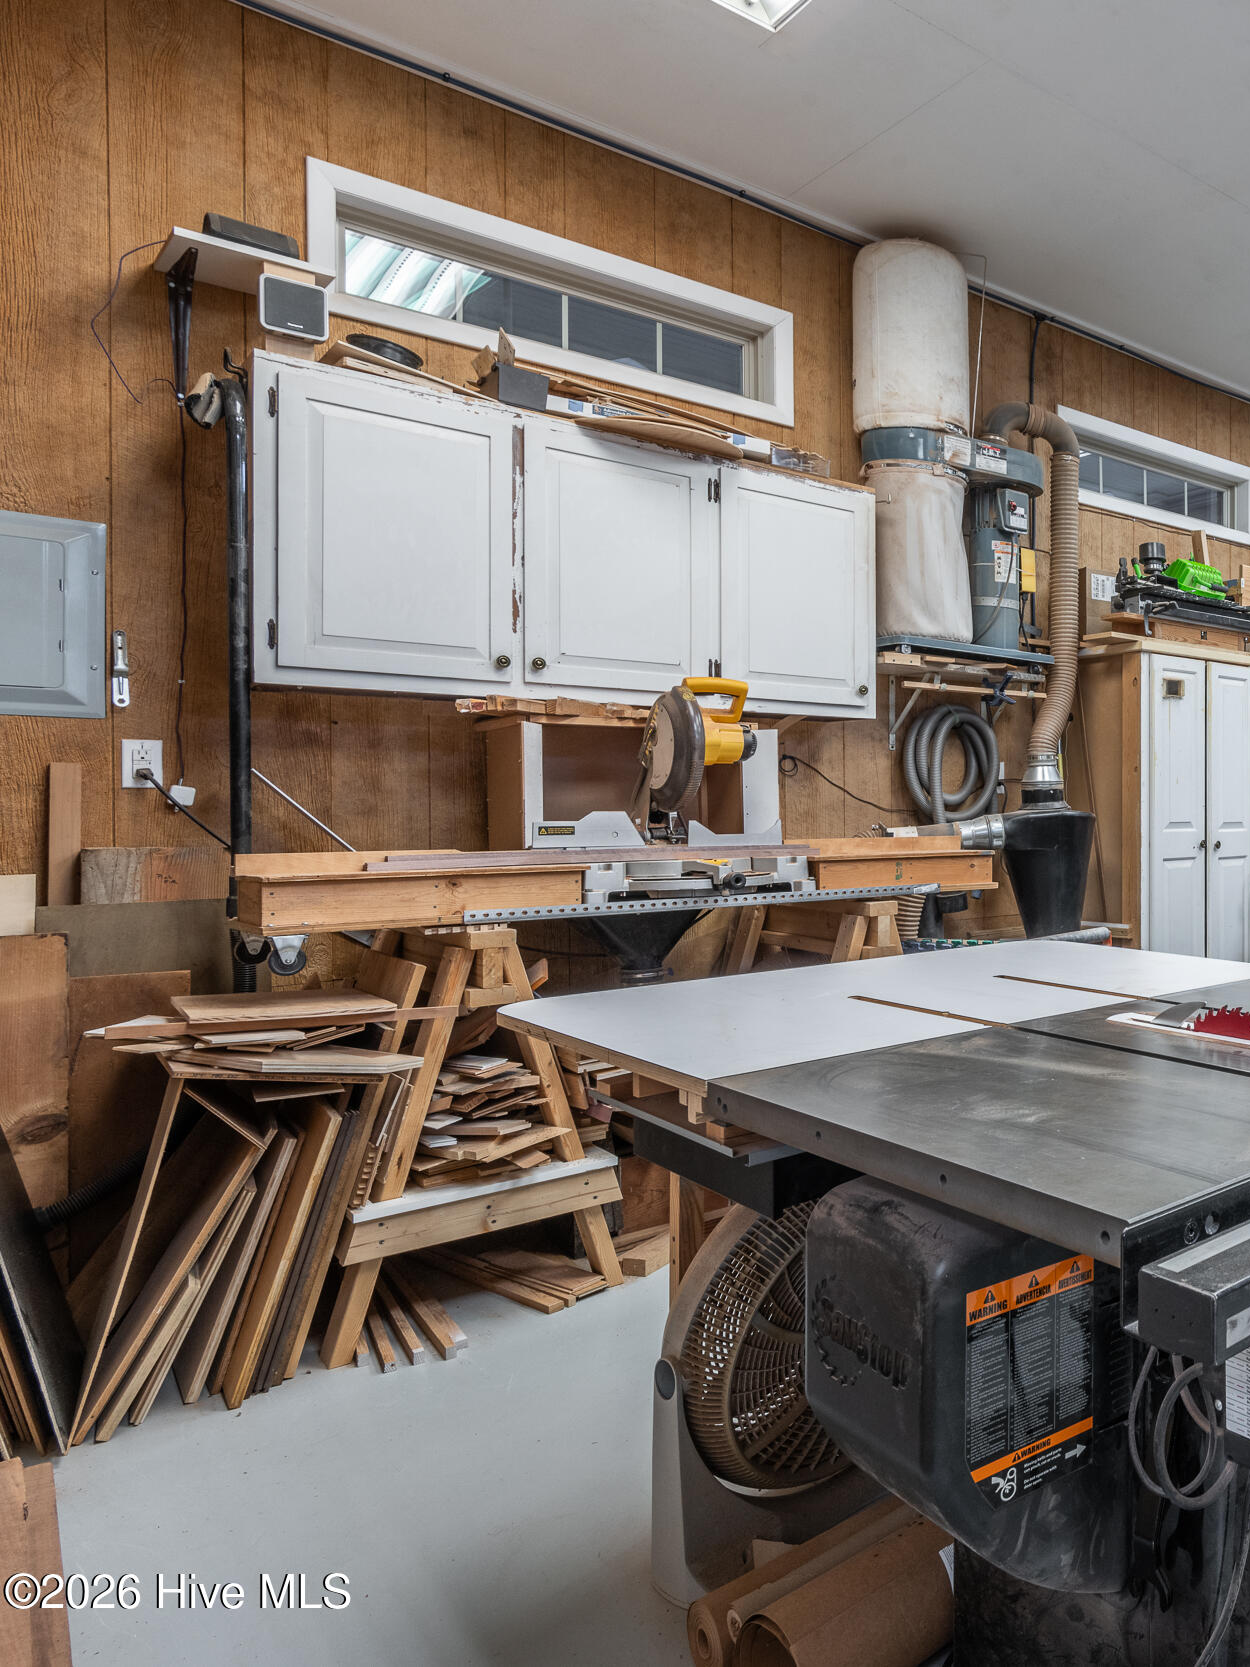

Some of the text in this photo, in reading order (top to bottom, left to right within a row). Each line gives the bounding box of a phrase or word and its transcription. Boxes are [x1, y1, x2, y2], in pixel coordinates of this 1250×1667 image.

[1058, 1269, 1092, 1290] AVERTISSEMENT
[1015, 1284, 1051, 1305] ADVERTENCIA
[969, 1300, 1008, 1321] WARNING
[1021, 1439, 1051, 1458] WARNING
